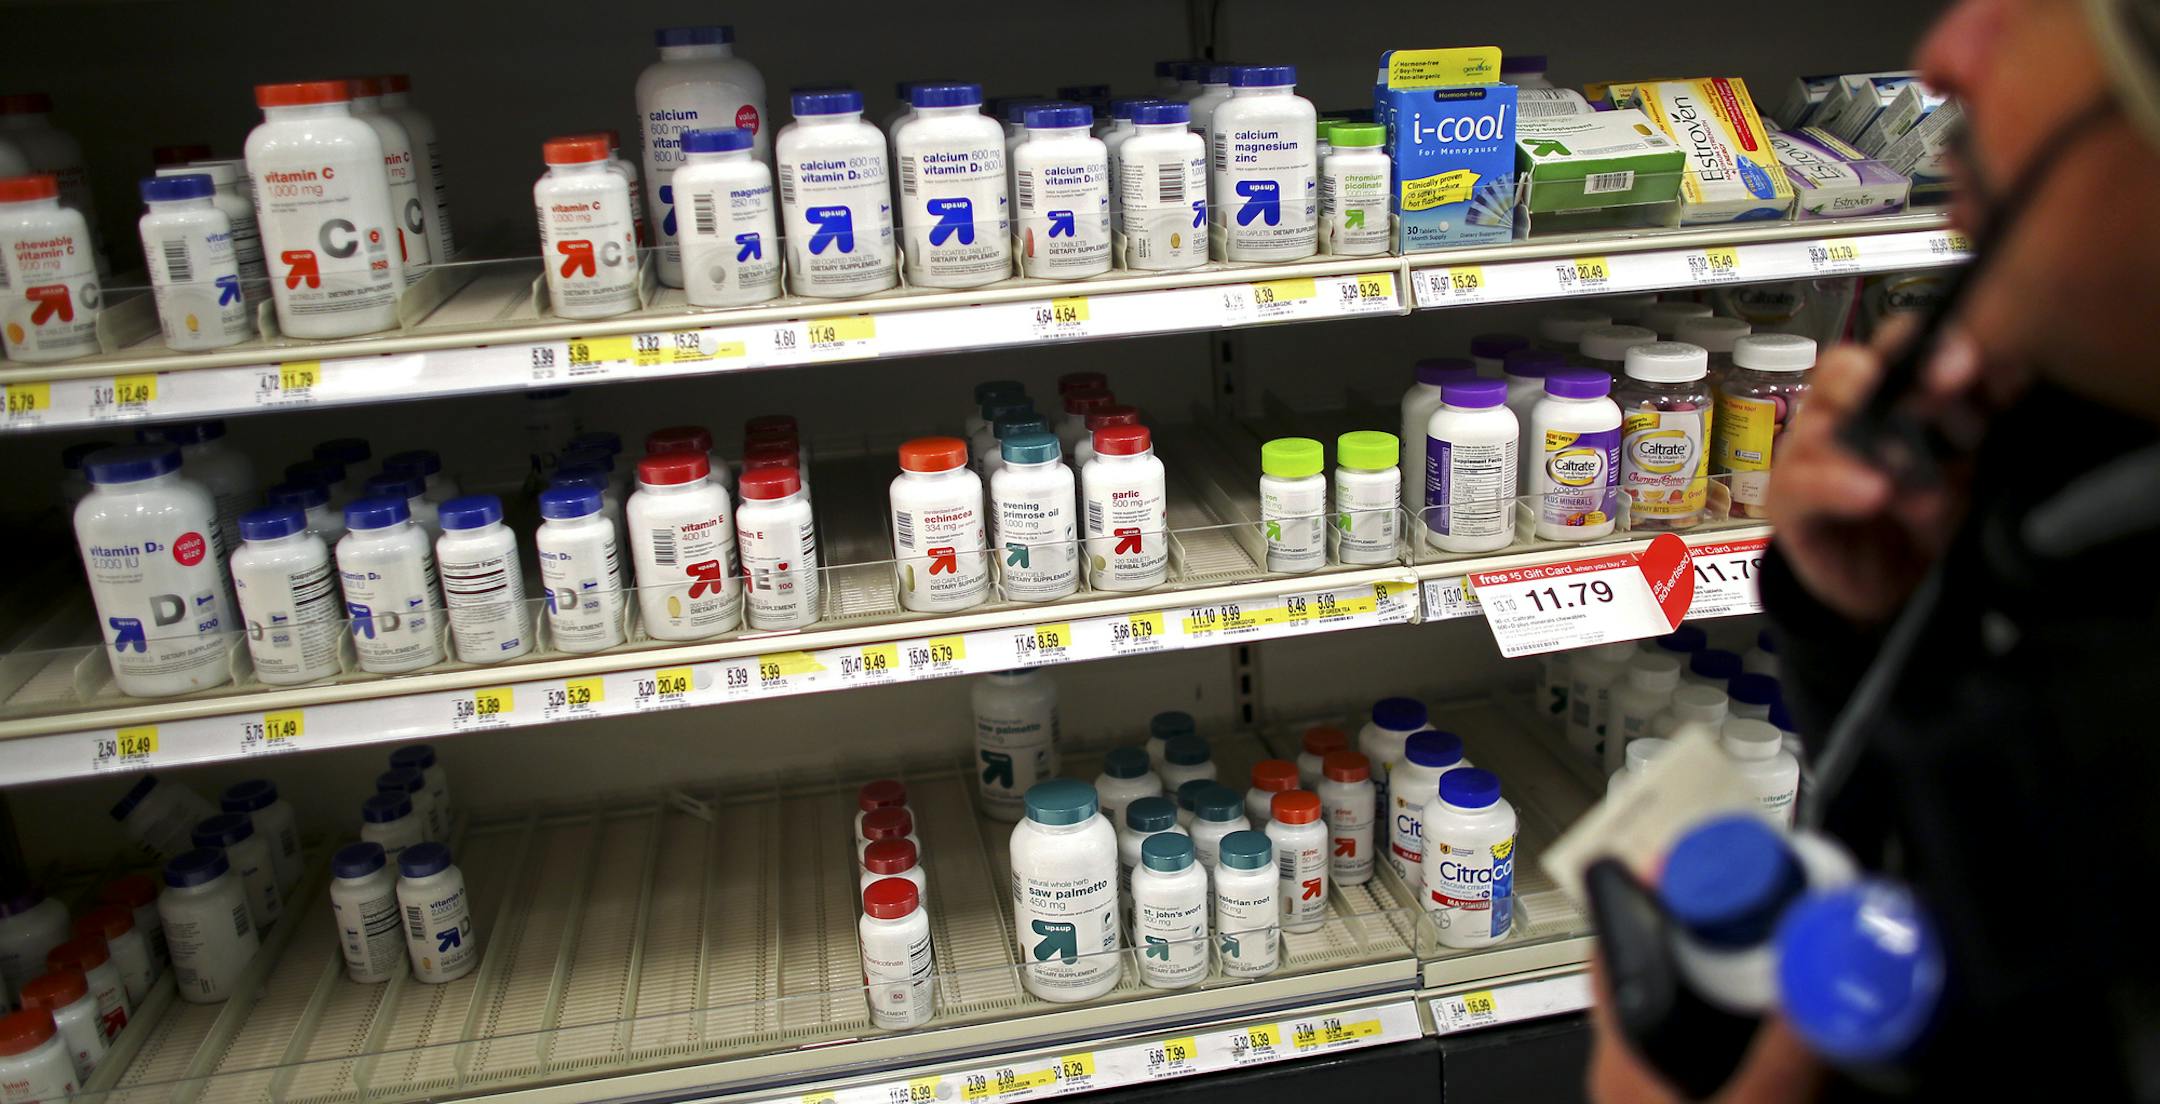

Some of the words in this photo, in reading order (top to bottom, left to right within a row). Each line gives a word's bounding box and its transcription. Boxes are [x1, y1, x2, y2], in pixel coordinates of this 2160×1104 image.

[649, 109, 698, 121] calcium
[651, 123, 675, 135] 600
[1413, 104, 1505, 145] i-cool
[1235, 130, 1279, 140] calcium
[1674, 96, 1724, 181] Estroven
[1235, 142, 1298, 153] magnesium
[1441, 146, 1498, 155] Menopause
[655, 152, 671, 162] 800
[923, 151, 969, 163] calcium
[971, 150, 988, 161] 600
[1235, 153, 1257, 163] zinc
[800, 159, 846, 171] calcium
[850, 157, 867, 168] 600
[924, 163, 966, 176] vitamin
[1045, 166, 1085, 176] calcium
[266, 170, 318, 183] vitamin
[322, 167, 335, 180] C
[801, 172, 844, 183] vitamin
[1045, 176, 1082, 186] vitamin
[1345, 174, 1383, 183] chromium
[1407, 177, 1439, 190] Clinically
[1440, 174, 1463, 184] proven
[269, 184, 298, 197] 1,000
[301, 184, 324, 196] mg
[552, 203, 589, 214] vitamin
[592, 201, 602, 211] C
[1407, 226, 1418, 235] 30
[1429, 233, 1446, 241] Supply
[15, 236, 73, 250] chewable
[319, 217, 359, 259] C
[17, 248, 64, 261] vitamin
[66, 246, 75, 256] C
[1829, 246, 1853, 260] 11.79
[1709, 255, 1732, 269] 15.49
[1578, 265, 1603, 279] 20.49
[1453, 274, 1478, 289] 15.29
[1254, 288, 1274, 304] 8.39
[1360, 281, 1380, 297] 9.29
[1055, 307, 1077, 322] 4.64
[638, 334, 660, 352] 3.82
[673, 332, 699, 350] 15.29
[775, 330, 796, 347] 4.60
[809, 327, 835, 343] 11.49
[533, 347, 554, 367] 5.99
[568, 345, 589, 363] 5.99
[283, 372, 313, 391] 11.79
[118, 386, 149, 404] 12.49
[9, 393, 34, 412] 5.79
[1640, 442, 1688, 456] Caltrate
[1554, 459, 1596, 472] Caltrate
[1112, 490, 1140, 500] garlic
[1559, 497, 1592, 506] MINERALS
[1003, 502, 1039, 511] evening
[1112, 500, 1128, 508] 500
[1130, 500, 1143, 508] mg
[924, 510, 973, 524] echinacea
[1003, 511, 1045, 520] primrose
[1048, 508, 1059, 517] oil
[681, 519, 718, 534] vitamin
[718, 514, 725, 524] E
[925, 524, 941, 532] 334
[943, 523, 957, 532] mg
[1004, 519, 1024, 528] 1,000
[1025, 520, 1039, 530] mg
[682, 533, 700, 542] 400
[757, 531, 764, 540] E
[91, 545, 140, 557] vitamin
[182, 549, 201, 559] size
[1705, 545, 1731, 555] Card
[126, 558, 139, 568] IU
[482, 557, 503, 570] Facts
[1115, 562, 1140, 570] HERBAL
[1033, 570, 1072, 582] SUPPLEMENT
[1479, 573, 1508, 585] free
[1510, 570, 1521, 580] $5
[1523, 568, 1544, 579] Gift
[1545, 565, 1572, 576] Card
[1575, 565, 1593, 573] when
[1593, 563, 1607, 571] you
[1607, 560, 1620, 569] buy
[1657, 552, 1691, 604] advertised
[778, 582, 793, 590] 100
[930, 583, 957, 591] DIETARY
[1653, 580, 1663, 595] as
[1317, 594, 1336, 609] 5.09
[1494, 599, 1517, 613] 13.10
[1525, 580, 1614, 612] 11.79
[150, 593, 186, 627] D
[584, 600, 599, 609] 100
[1191, 610, 1215, 625] 11.10
[1221, 605, 1241, 622] 9.99
[199, 618, 219, 632] 500
[1132, 621, 1152, 637] 6.79
[1015, 636, 1036, 651] 11.45
[1038, 633, 1059, 649] 8.59
[931, 646, 953, 663] 6.79
[864, 654, 886, 670] 9.49
[728, 669, 748, 685] 5.99
[760, 665, 780, 681] 5.99
[638, 681, 655, 697] 8.20
[658, 677, 687, 694] 20.49
[549, 690, 566, 706] 5.29
[568, 688, 591, 704] 5.29
[477, 698, 500, 714] 5.89
[266, 720, 297, 737] 11.49
[98, 740, 117, 758] 2.50
[120, 736, 150, 753] 12.49
[1302, 849, 1319, 857] zinc
[1073, 877, 1089, 887] herb
[1440, 880, 1466, 890] CALCIUM
[1029, 886, 1052, 898] saw
[1056, 880, 1108, 901] palmetto
[1049, 901, 1066, 912] mg
[1253, 895, 1270, 905] root
[1156, 909, 1183, 919] john's
[1185, 905, 1202, 916] wort
[1159, 918, 1171, 927] mg
[1467, 999, 1490, 1014] 16.99
[1296, 1023, 1315, 1040] 3.04
[1324, 1018, 1341, 1035] 3.04
[1250, 1033, 1269, 1048] 8.39
[1166, 1046, 1185, 1061] 7.99
[1063, 1062, 1083, 1078] 6.29
[967, 1074, 986, 1091] 2.89
[995, 1069, 1015, 1085] 2.89
[911, 1085, 931, 1101] 6.99
